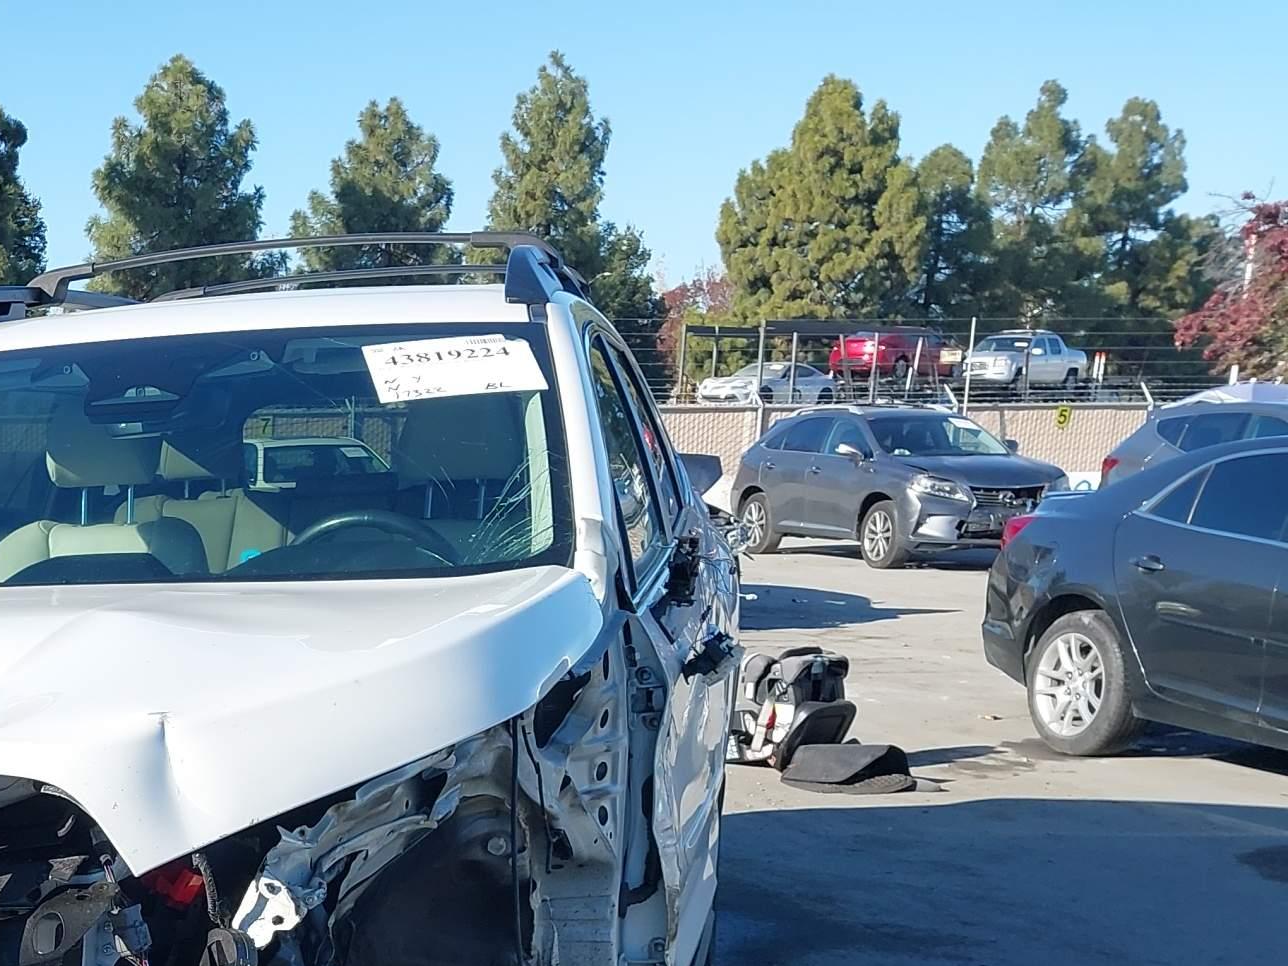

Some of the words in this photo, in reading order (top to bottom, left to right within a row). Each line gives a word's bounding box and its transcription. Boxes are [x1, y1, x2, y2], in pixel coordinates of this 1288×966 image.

[384, 346, 510, 366] 43819224
[1058, 409, 1067, 424] 5
[260, 418, 271, 434] 7
